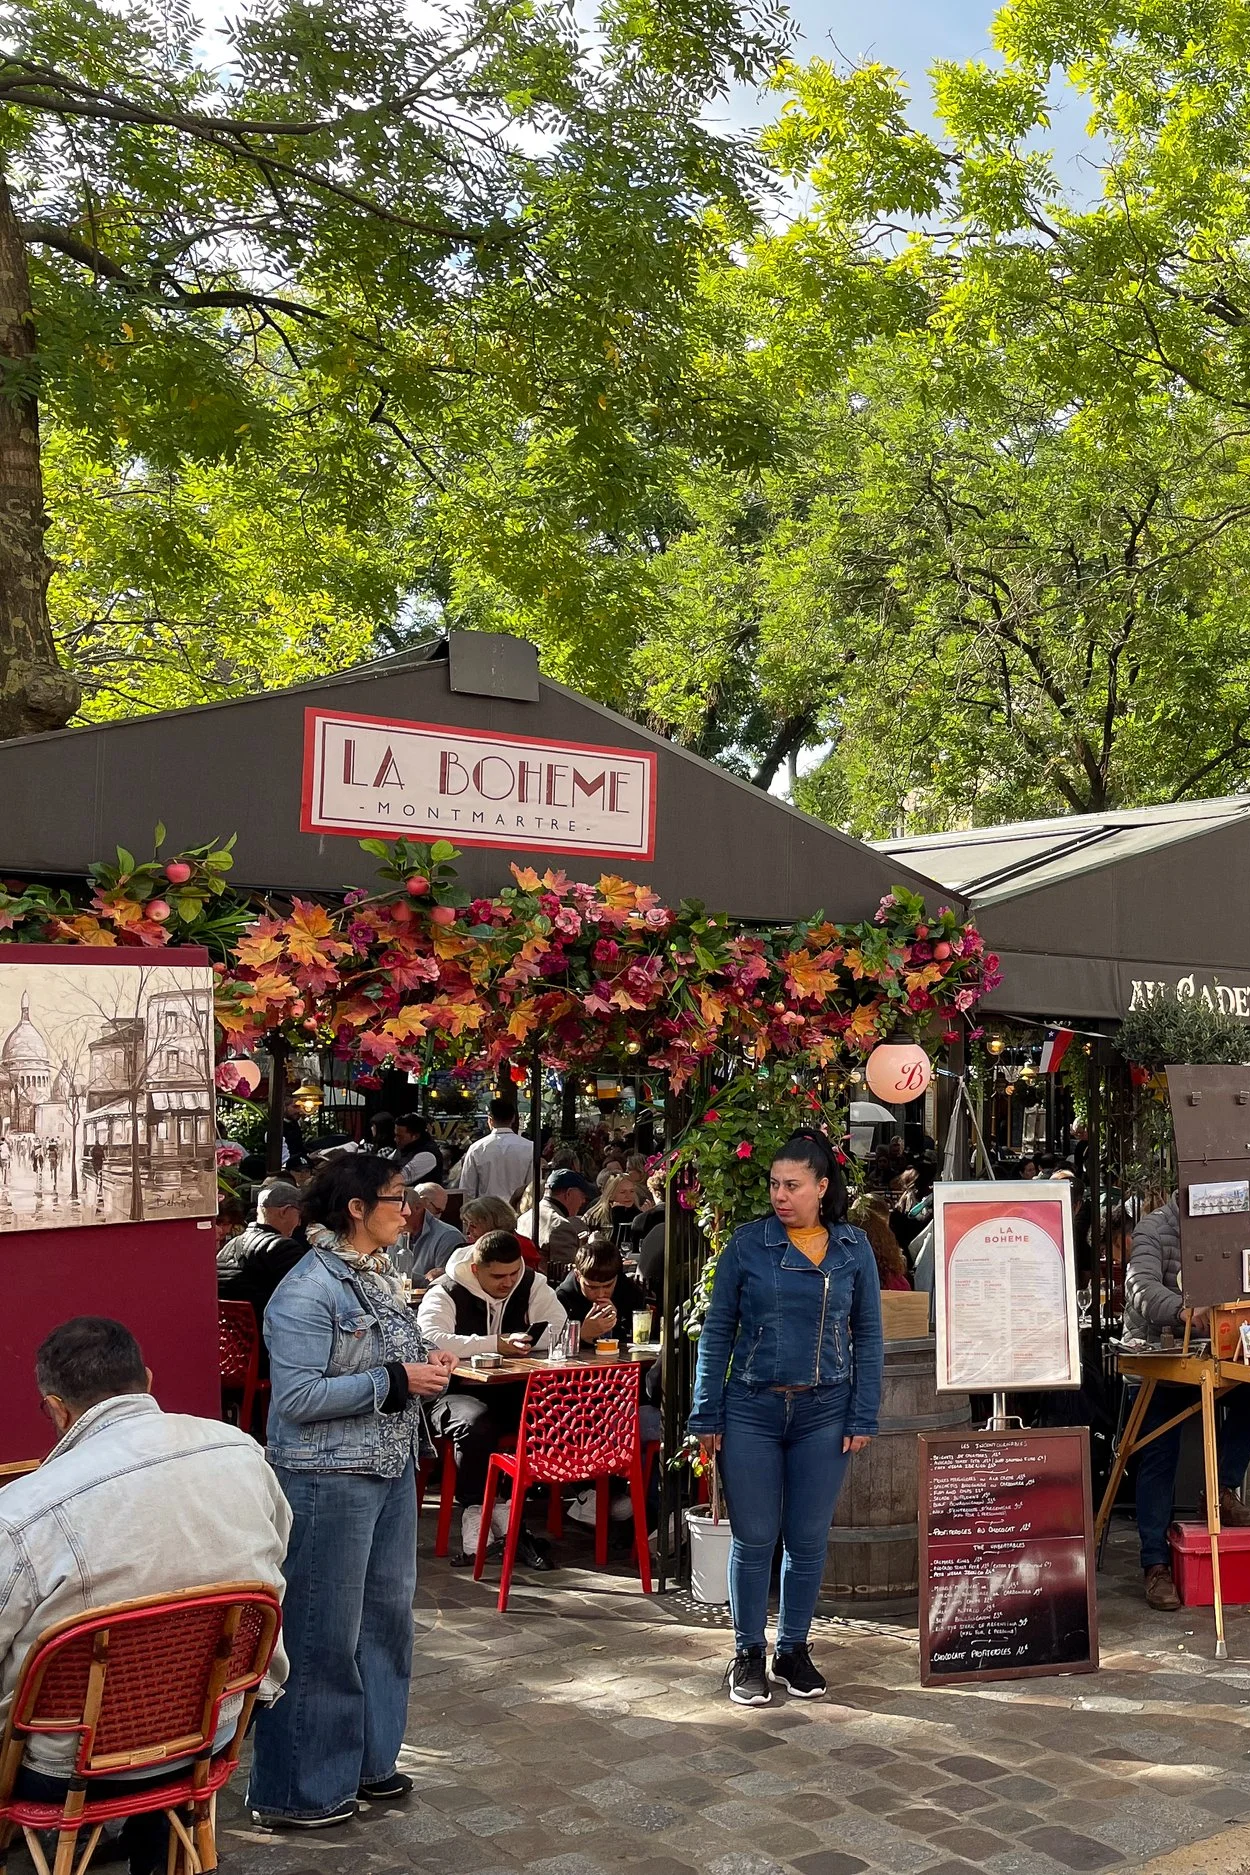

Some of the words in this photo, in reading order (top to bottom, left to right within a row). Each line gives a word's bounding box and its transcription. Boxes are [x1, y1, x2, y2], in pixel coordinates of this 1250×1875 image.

[342, 739, 405, 790] LA
[438, 750, 631, 814] BOHEME
[894, 1060, 923, 1091] B
